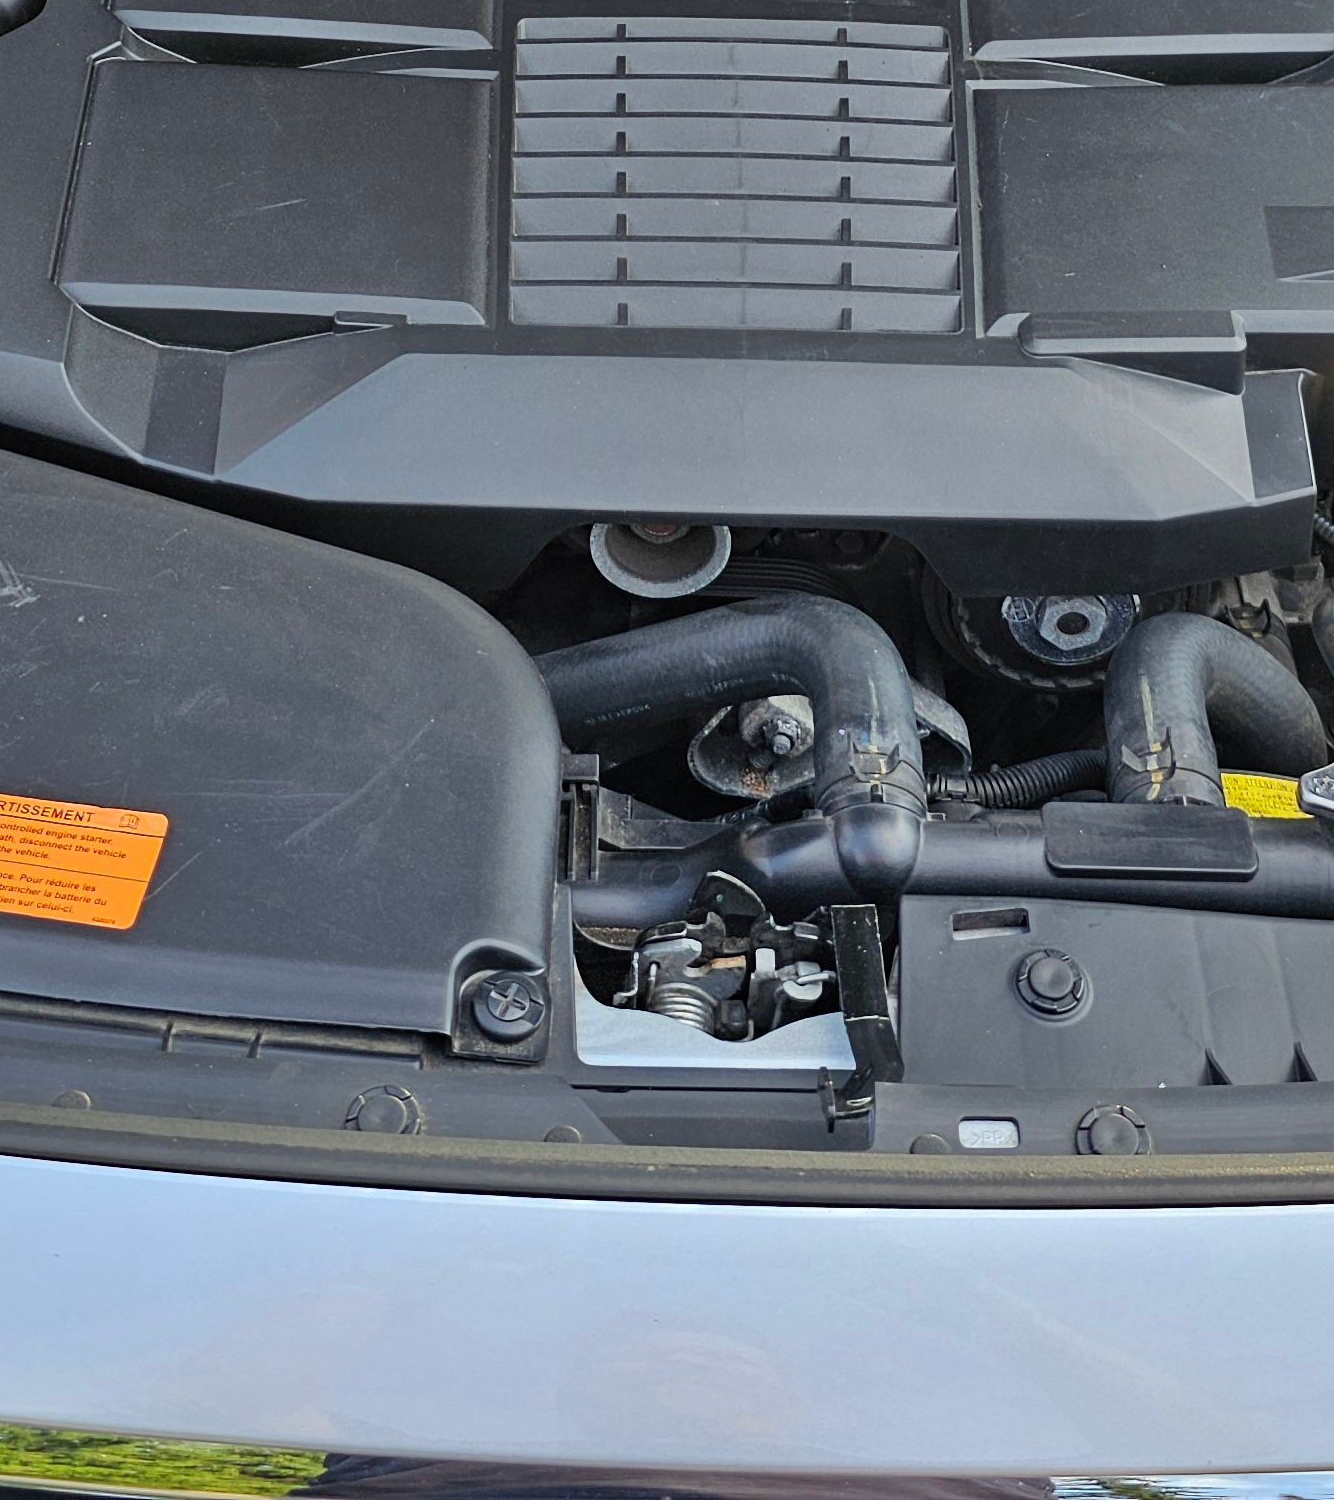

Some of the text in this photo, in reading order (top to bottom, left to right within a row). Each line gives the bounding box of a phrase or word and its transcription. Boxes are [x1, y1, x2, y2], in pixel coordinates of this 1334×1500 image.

[45, 830, 76, 840] engine
[19, 837, 72, 849] disconnect
[94, 848, 126, 858] vehicle
[20, 874, 43, 883] Pour
[55, 892, 91, 903] batterie
